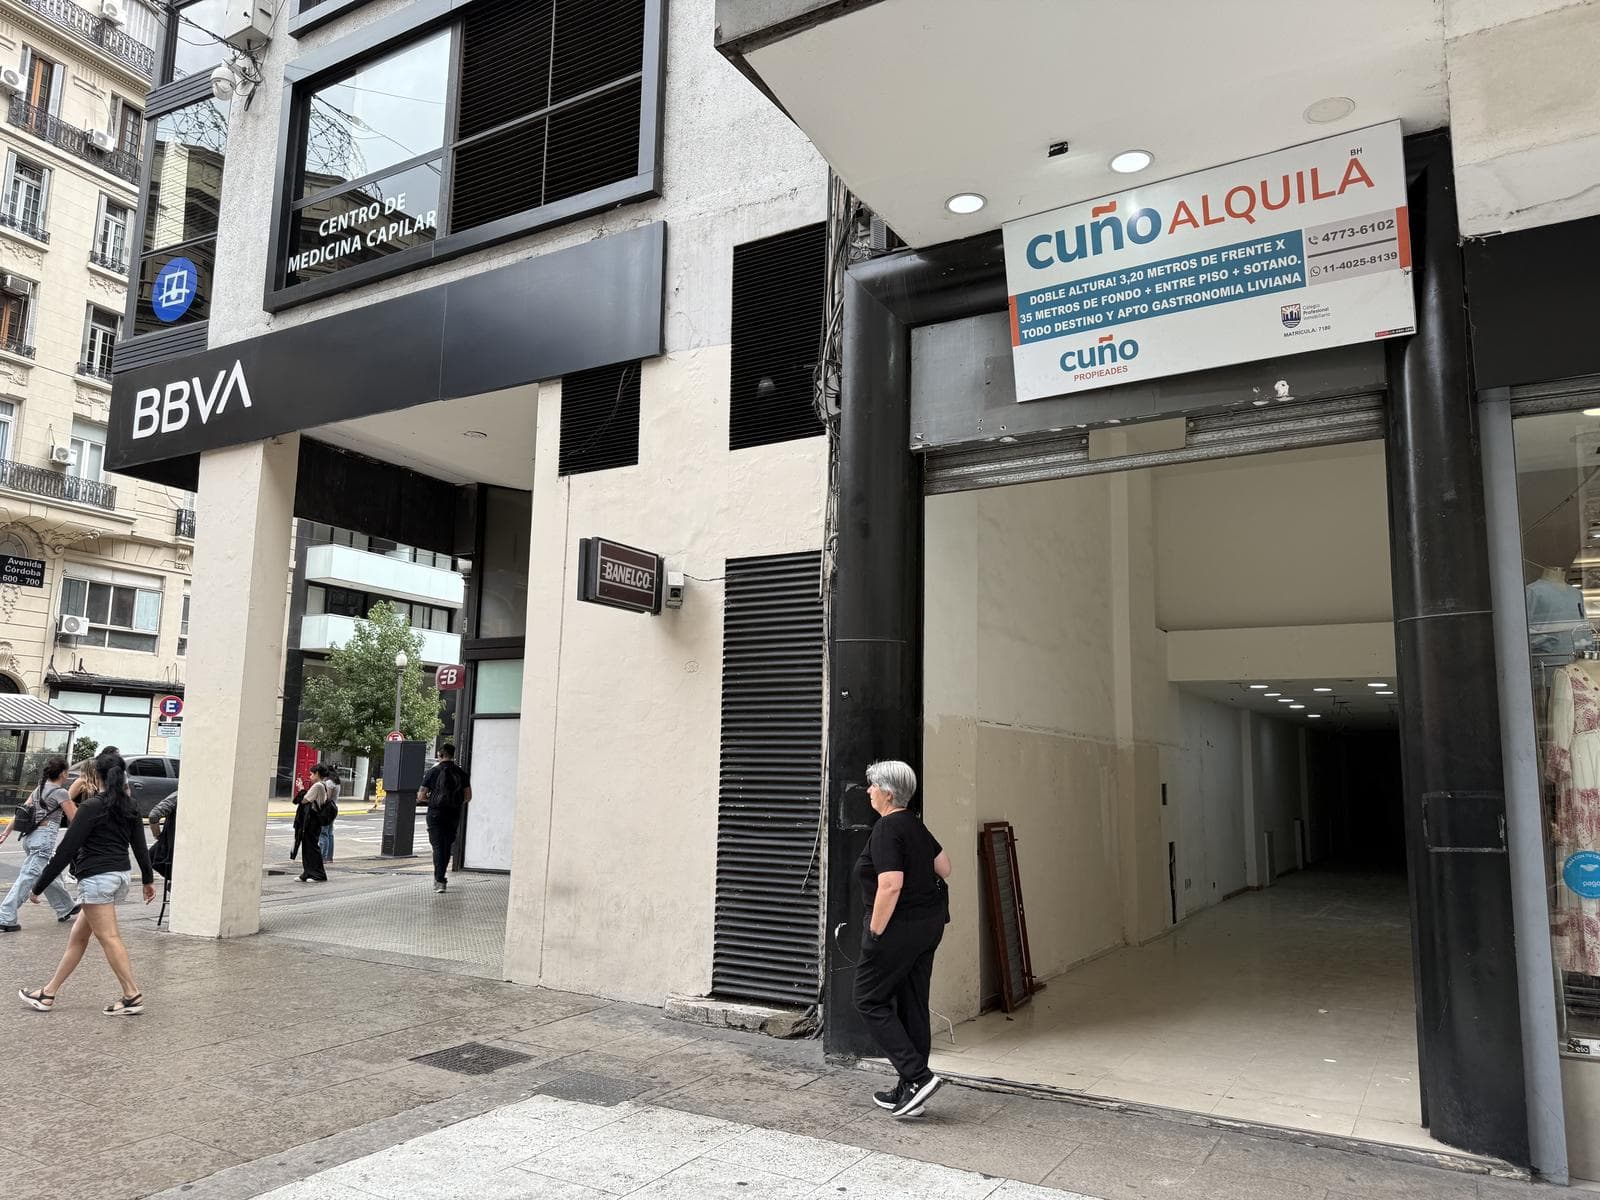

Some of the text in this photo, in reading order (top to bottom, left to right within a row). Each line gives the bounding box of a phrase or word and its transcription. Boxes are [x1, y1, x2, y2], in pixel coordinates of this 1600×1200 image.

[1350, 147, 1363, 156] BH
[319, 192, 406, 237] CENTRO DE
[1026, 157, 1375, 270] cuño ALQUILA
[287, 210, 438, 274] MEDICINA CAPILAR
[1321, 218, 1395, 243] 4773-6102
[1029, 239, 1286, 306] DOBLE ALTURA! 3,20 METROS DE FRENTE X
[1322, 251, 1398, 274] 11-4025-8139
[1020, 254, 1302, 324] 35 METROS DE FONDO + ENTRE PISO + SOTANO.
[1022, 272, 1302, 340] TODO DESTINO Y APTO GASTRONOMIA LIVIANA
[1059, 334, 1139, 372] cuño
[1074, 364, 1129, 382] PROPIEADES
[132, 359, 252, 440] BBVA
[5, 564, 41, 577] Córdoba
[7, 557, 42, 569] Avenida
[604, 561, 650, 589] BANELCO
[2, 574, 18, 583] 600
[25, 577, 40, 586] 700
[165, 700, 177, 713] E
